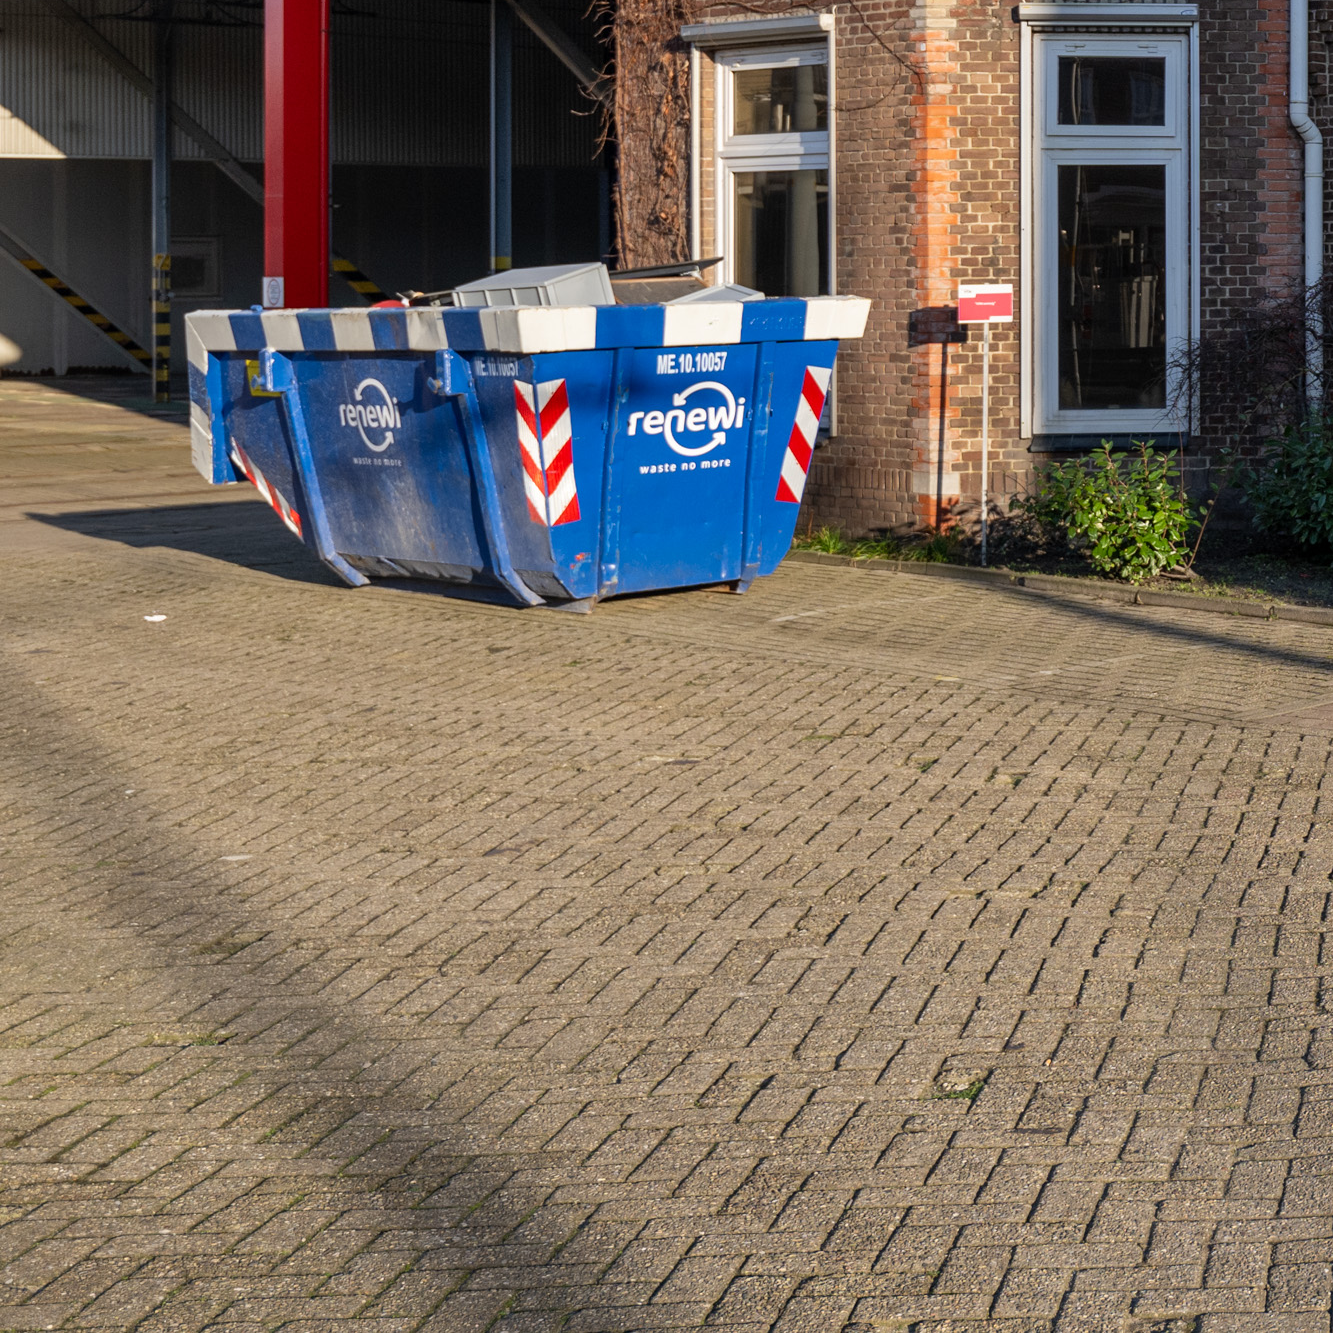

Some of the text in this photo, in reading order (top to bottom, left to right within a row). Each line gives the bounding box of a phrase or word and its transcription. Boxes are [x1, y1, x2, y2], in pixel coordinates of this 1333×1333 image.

[657, 352, 727, 375] ME.10.10057
[338, 397, 401, 429] renewi
[627, 397, 746, 436] renewi
[353, 457, 402, 467] waste no more
[639, 458, 731, 474] waste no more
